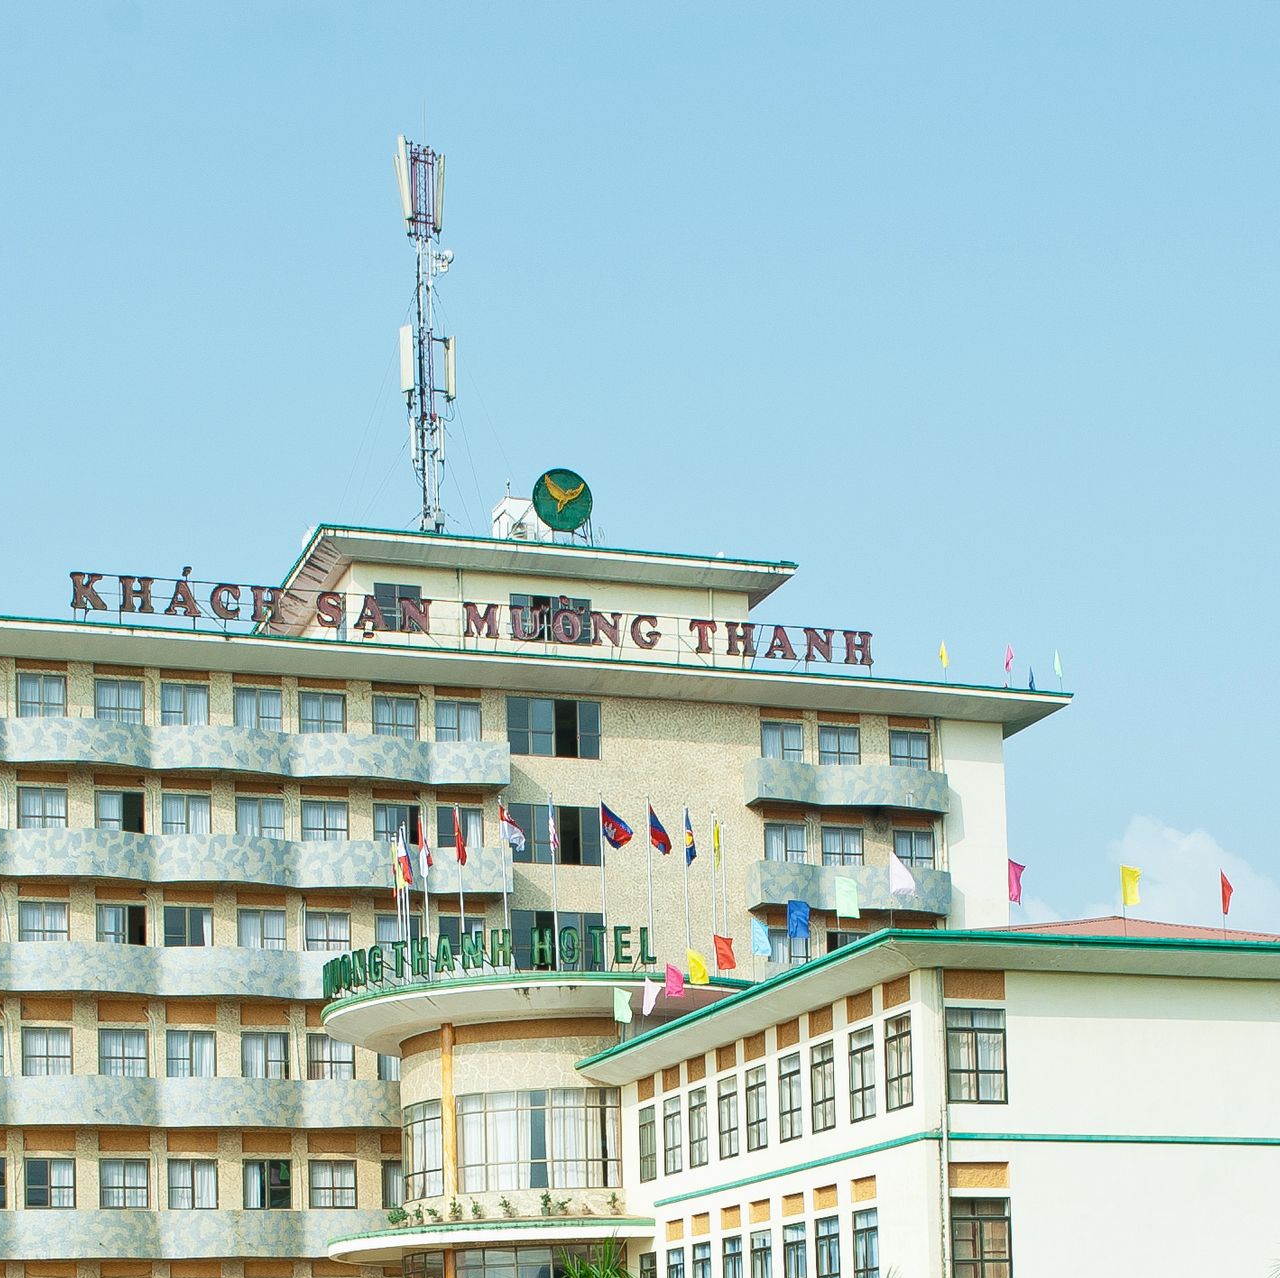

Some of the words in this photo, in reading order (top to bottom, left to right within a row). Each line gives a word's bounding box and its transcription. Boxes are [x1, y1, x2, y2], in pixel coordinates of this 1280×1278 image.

[689, 619, 874, 666] THANH
[392, 928, 512, 978] THANH
[531, 925, 658, 967] HOTEL
